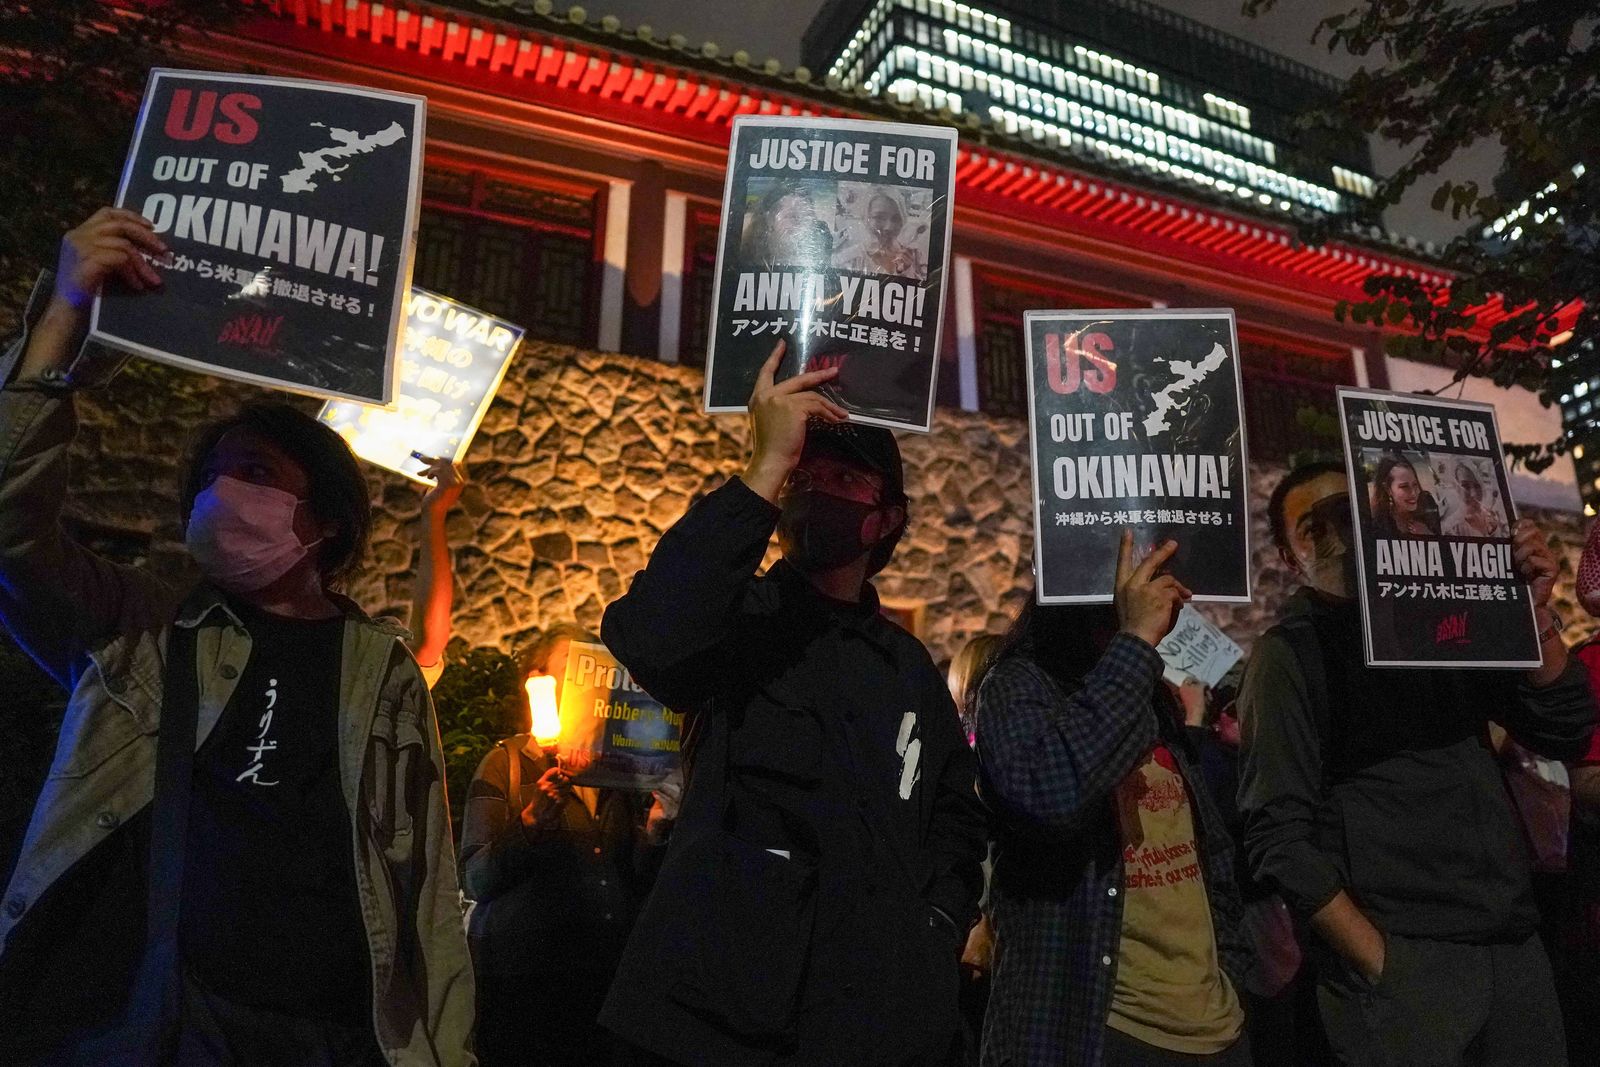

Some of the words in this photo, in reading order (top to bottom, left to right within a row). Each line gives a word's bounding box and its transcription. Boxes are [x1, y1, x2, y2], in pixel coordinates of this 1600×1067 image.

[164, 88, 262, 144] US
[153, 155, 218, 184] OUT
[226, 160, 269, 190] OF
[750, 138, 870, 174] JUSTICE
[879, 145, 936, 181] FOR
[141, 193, 385, 287] OKINAWA!
[733, 272, 826, 313] ANNA
[839, 275, 926, 328] YAGI!
[443, 308, 513, 352] WAR
[1045, 332, 1117, 395] US
[1050, 412, 1096, 443] OUT
[1103, 412, 1134, 441] OF
[1358, 410, 1447, 447] JUSTICE
[1448, 418, 1491, 451] FOR
[1053, 454, 1232, 500] OKINAWA!
[1376, 539, 1445, 577] ANNA
[1450, 542, 1515, 579] YAGI!
[576, 654, 643, 693] Prot
